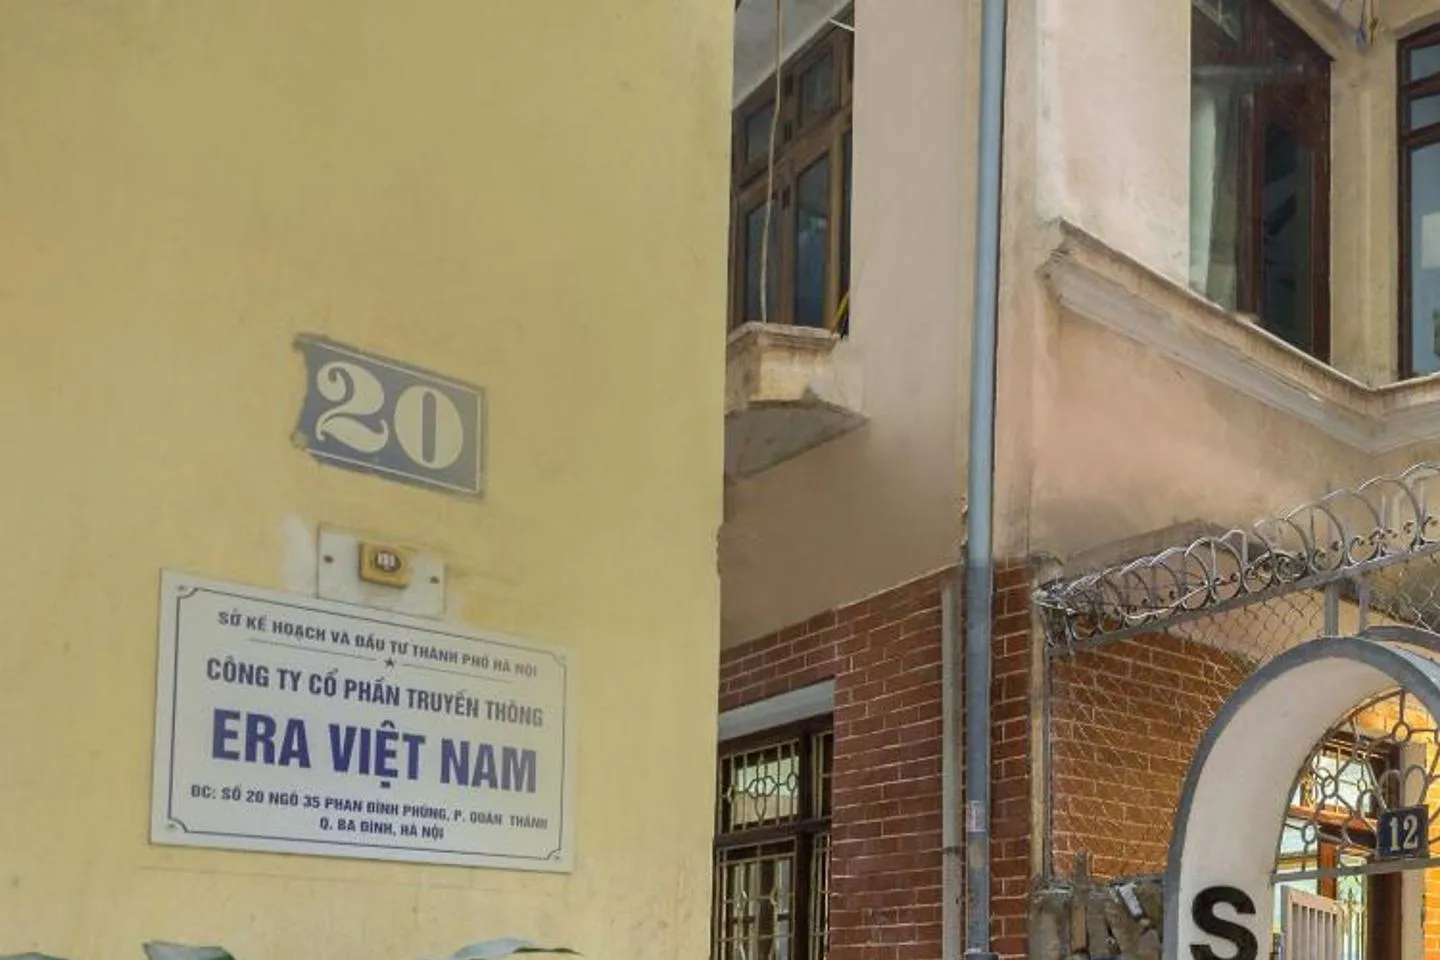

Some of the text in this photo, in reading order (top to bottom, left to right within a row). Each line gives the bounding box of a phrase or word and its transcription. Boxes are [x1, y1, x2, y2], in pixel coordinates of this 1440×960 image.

[315, 360, 464, 470] 20
[206, 655, 271, 689] CÔNG
[276, 667, 302, 692] TY
[308, 668, 339, 698] CỔ
[212, 707, 538, 794] ERA VIỆT NAM
[245, 790, 265, 804] 20
[302, 795, 320, 809] 35
[324, 797, 363, 814] PHAN
[337, 819, 357, 833] BA
[1389, 814, 1419, 852] 12
